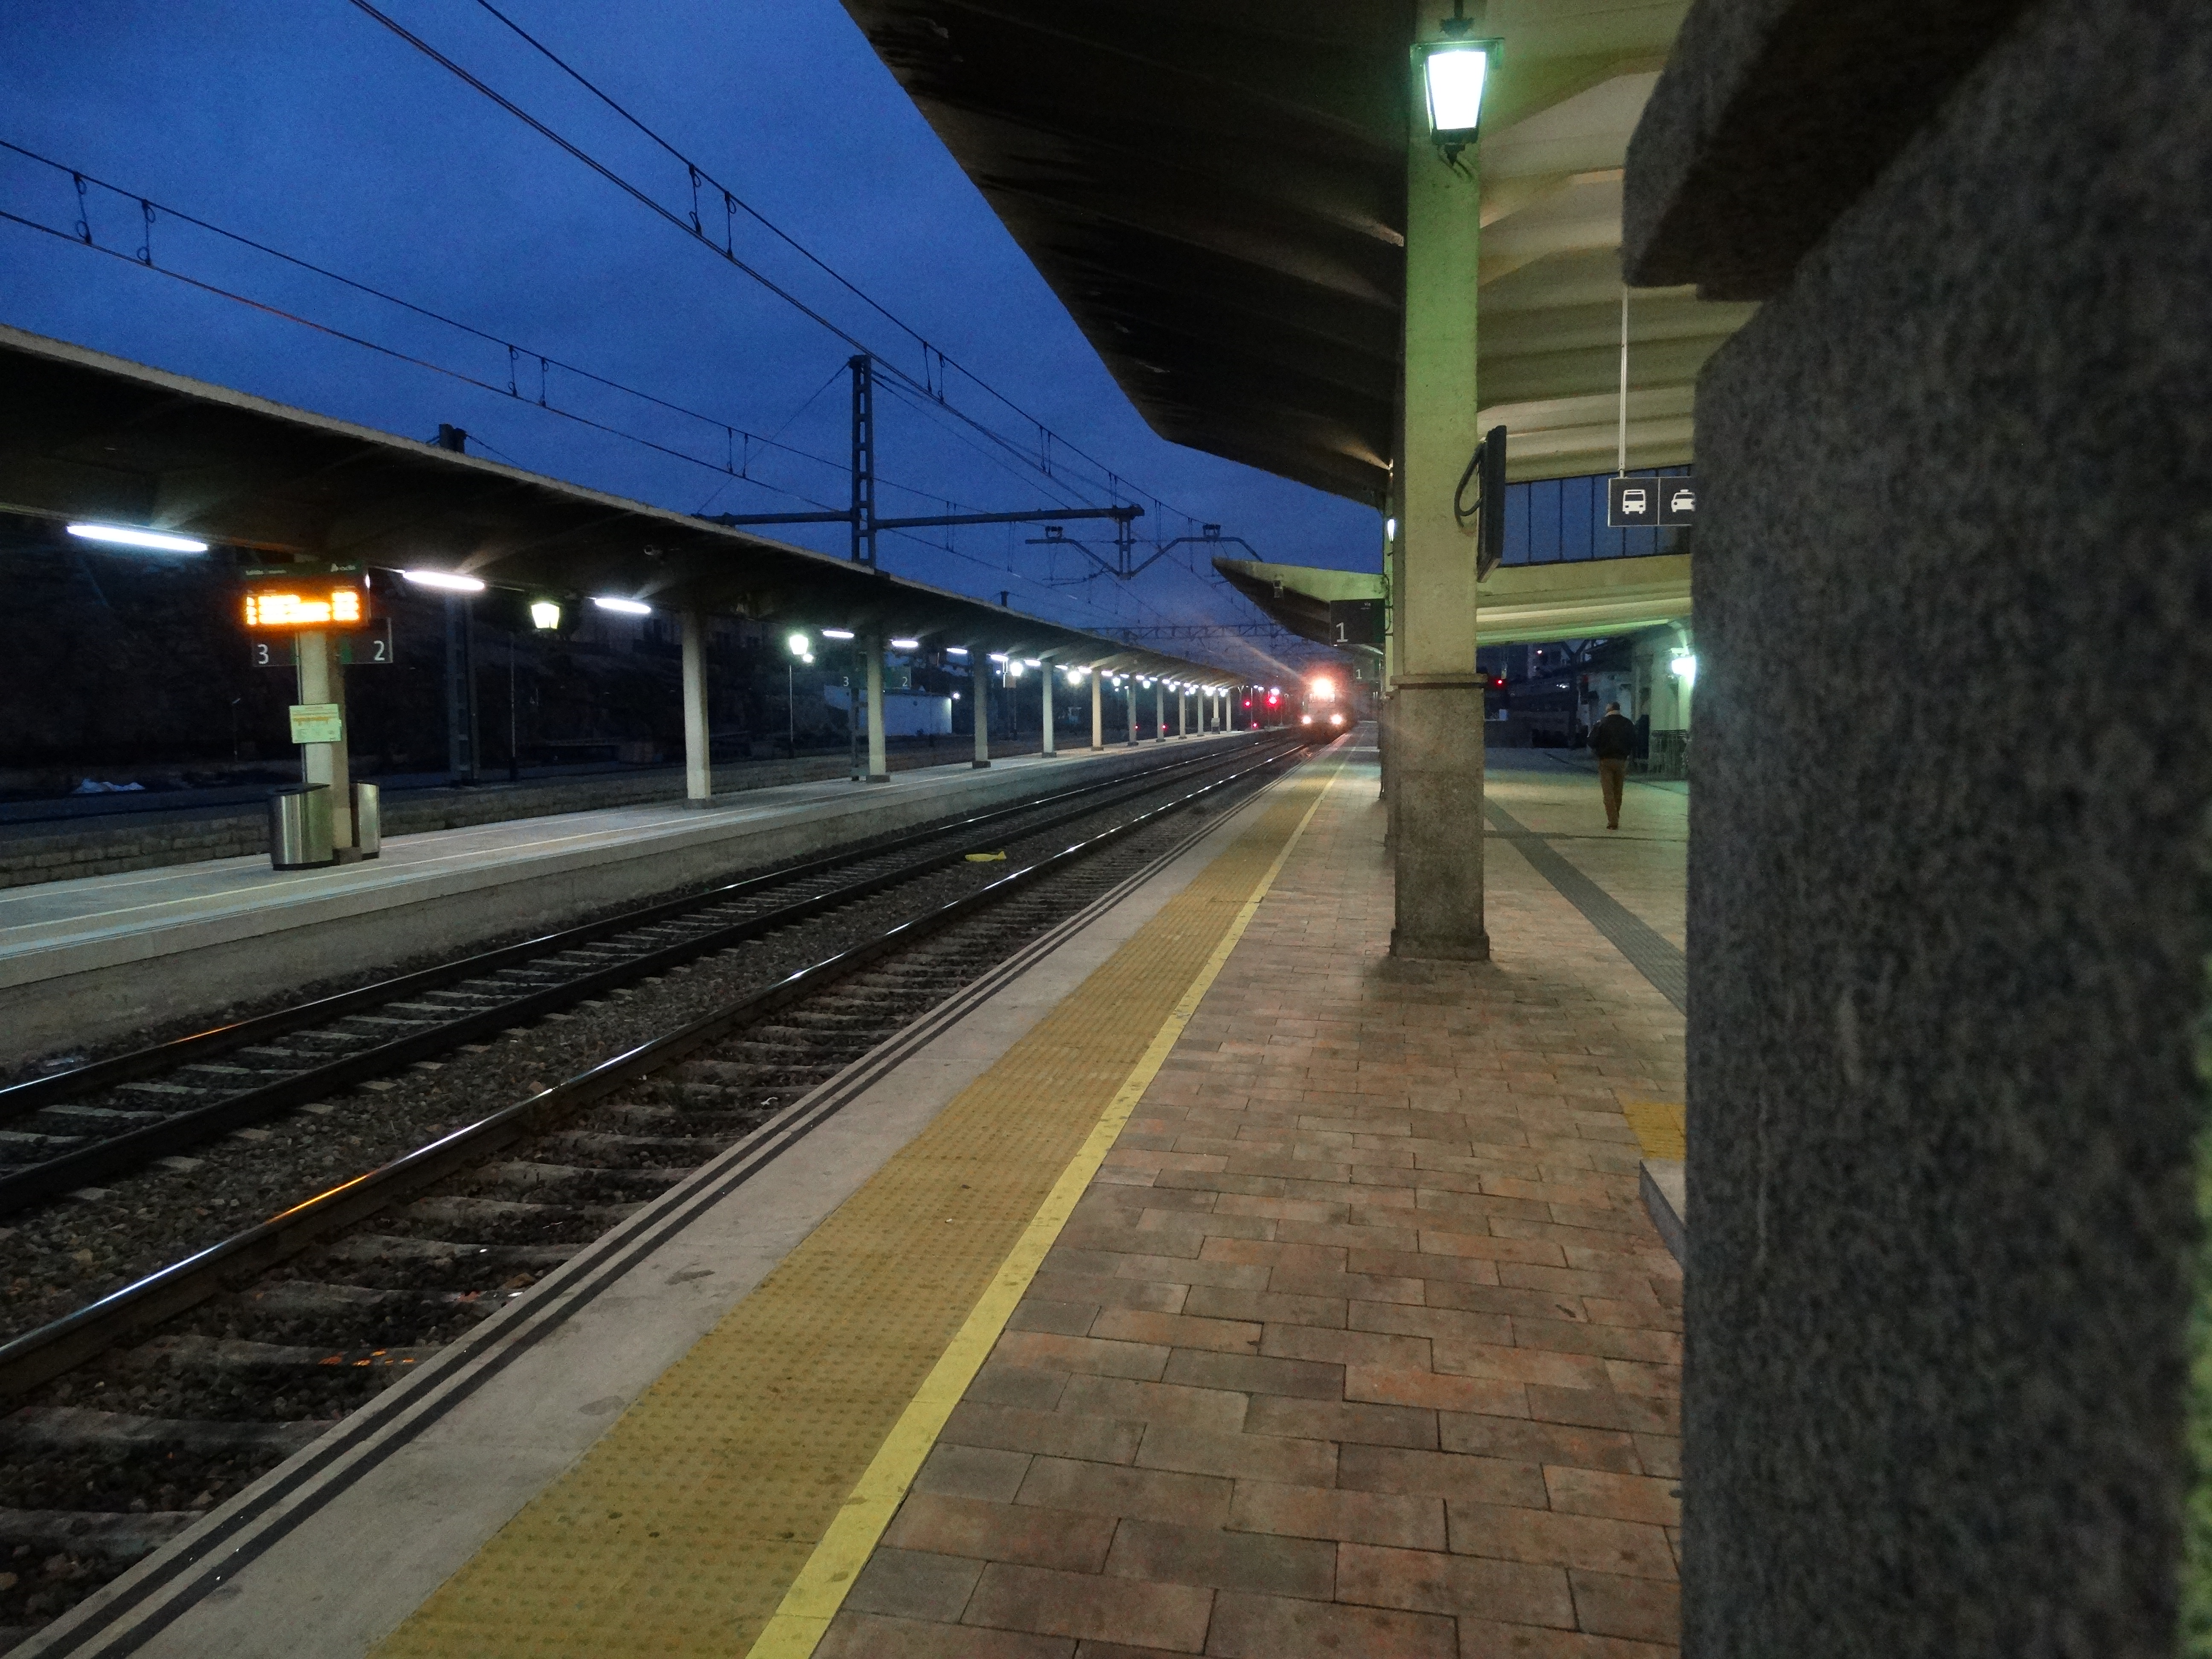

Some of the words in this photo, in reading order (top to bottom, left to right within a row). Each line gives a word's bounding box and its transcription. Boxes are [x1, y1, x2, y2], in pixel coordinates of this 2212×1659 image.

[1336, 622, 1348, 643] 1
[258, 643, 269, 664] 3
[374, 640, 385, 661] 2
[843, 676, 849, 687] 3
[902, 676, 908, 687] 2
[1356, 669, 1362, 679] 1
